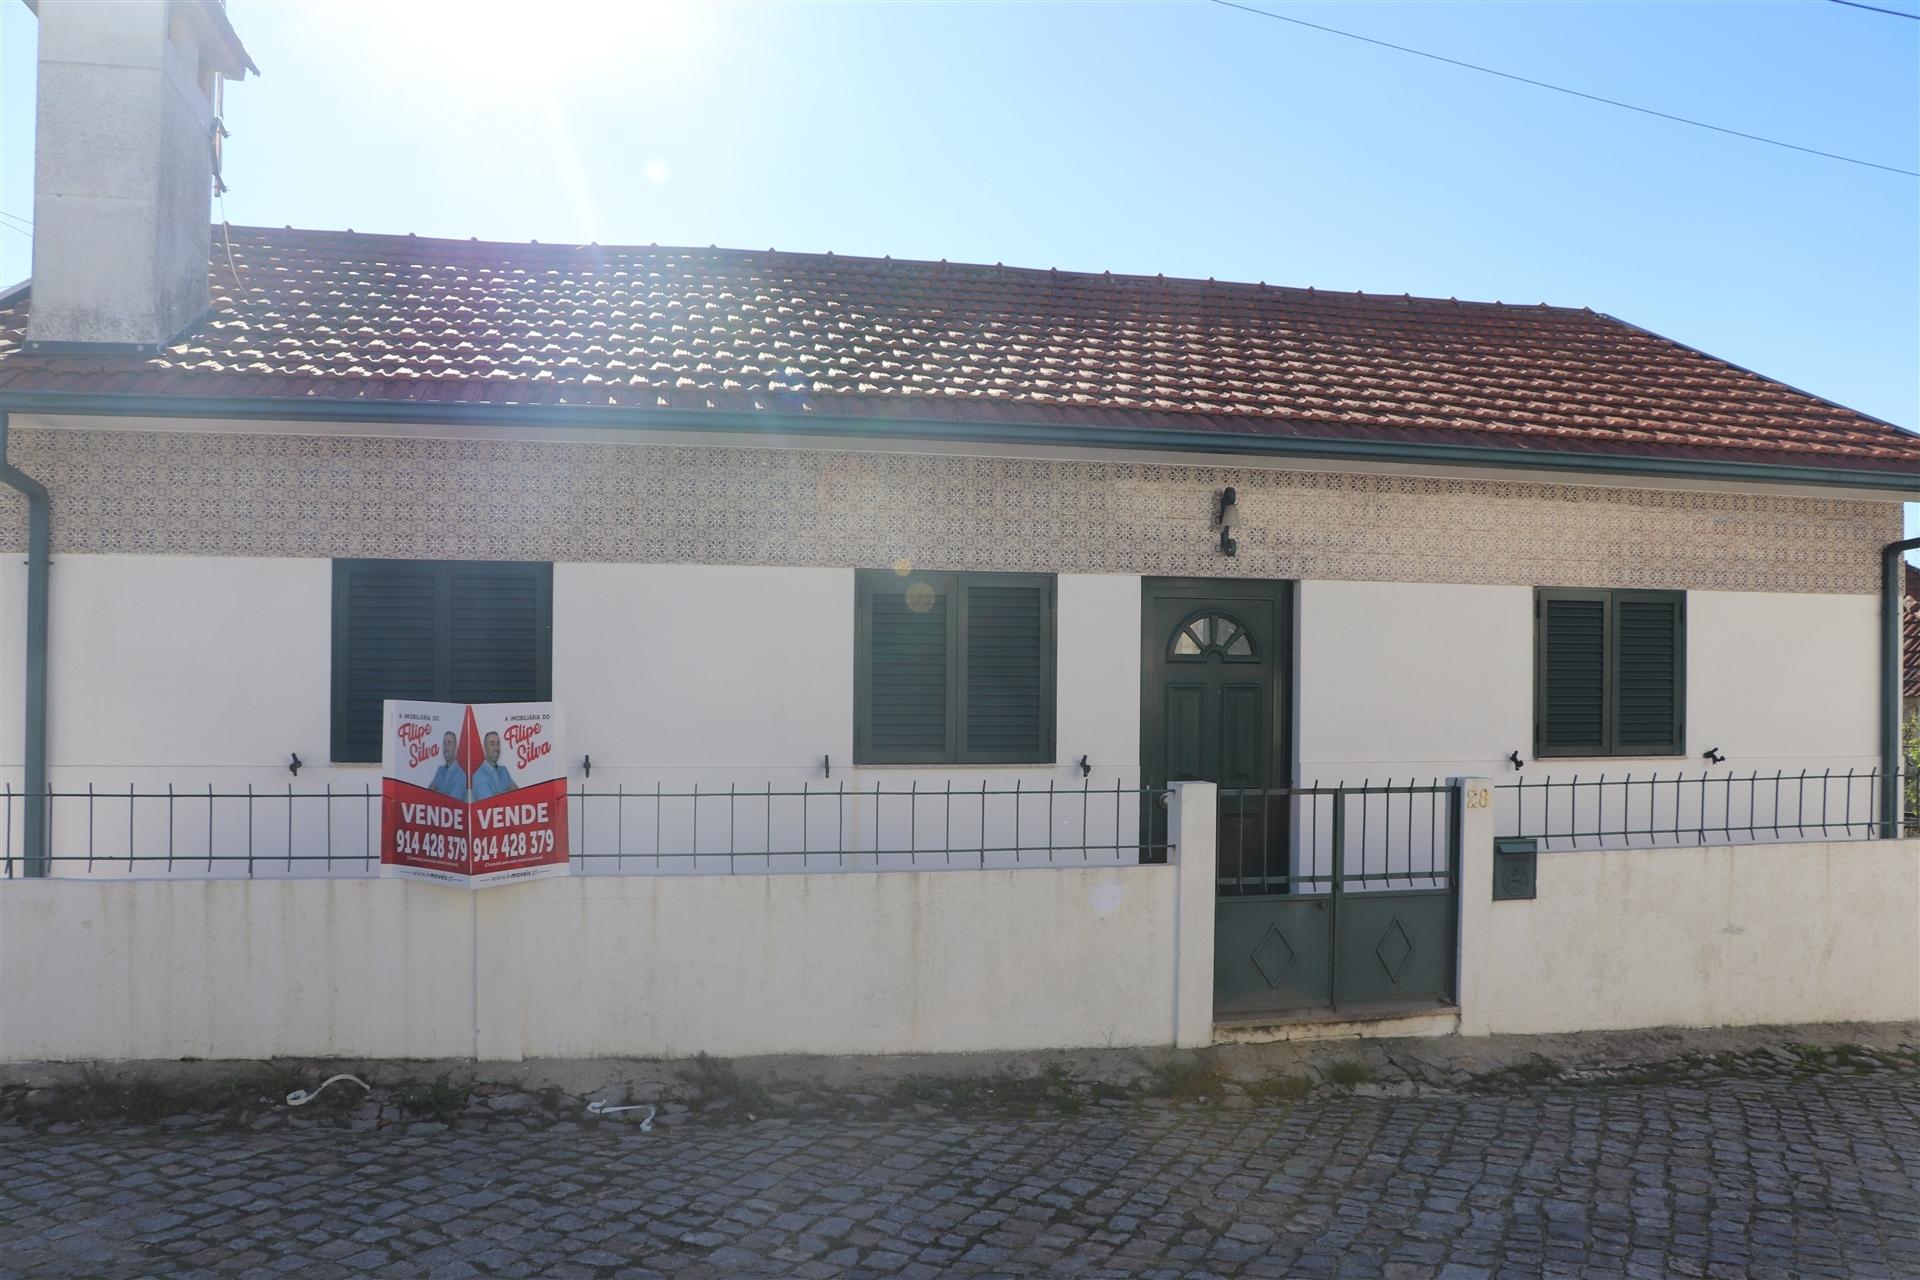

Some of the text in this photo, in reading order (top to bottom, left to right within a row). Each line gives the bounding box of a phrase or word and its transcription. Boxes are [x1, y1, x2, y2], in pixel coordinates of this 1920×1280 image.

[510, 714, 541, 722] IMOBILIÁRIA
[541, 713, 551, 721] DO
[397, 722, 432, 747] Filipe
[503, 722, 542, 749] Filipe
[409, 741, 440, 768] Silva
[516, 739, 552, 770] Silva
[1466, 788, 1488, 808] 28
[400, 802, 464, 831] VENDE
[476, 802, 549, 830] VENDE
[396, 829, 420, 855] 914
[422, 832, 445, 860] 428
[447, 836, 468, 862] 379
[473, 836, 498, 862] 914
[501, 832, 526, 858] 428
[529, 828, 554, 856] 379
